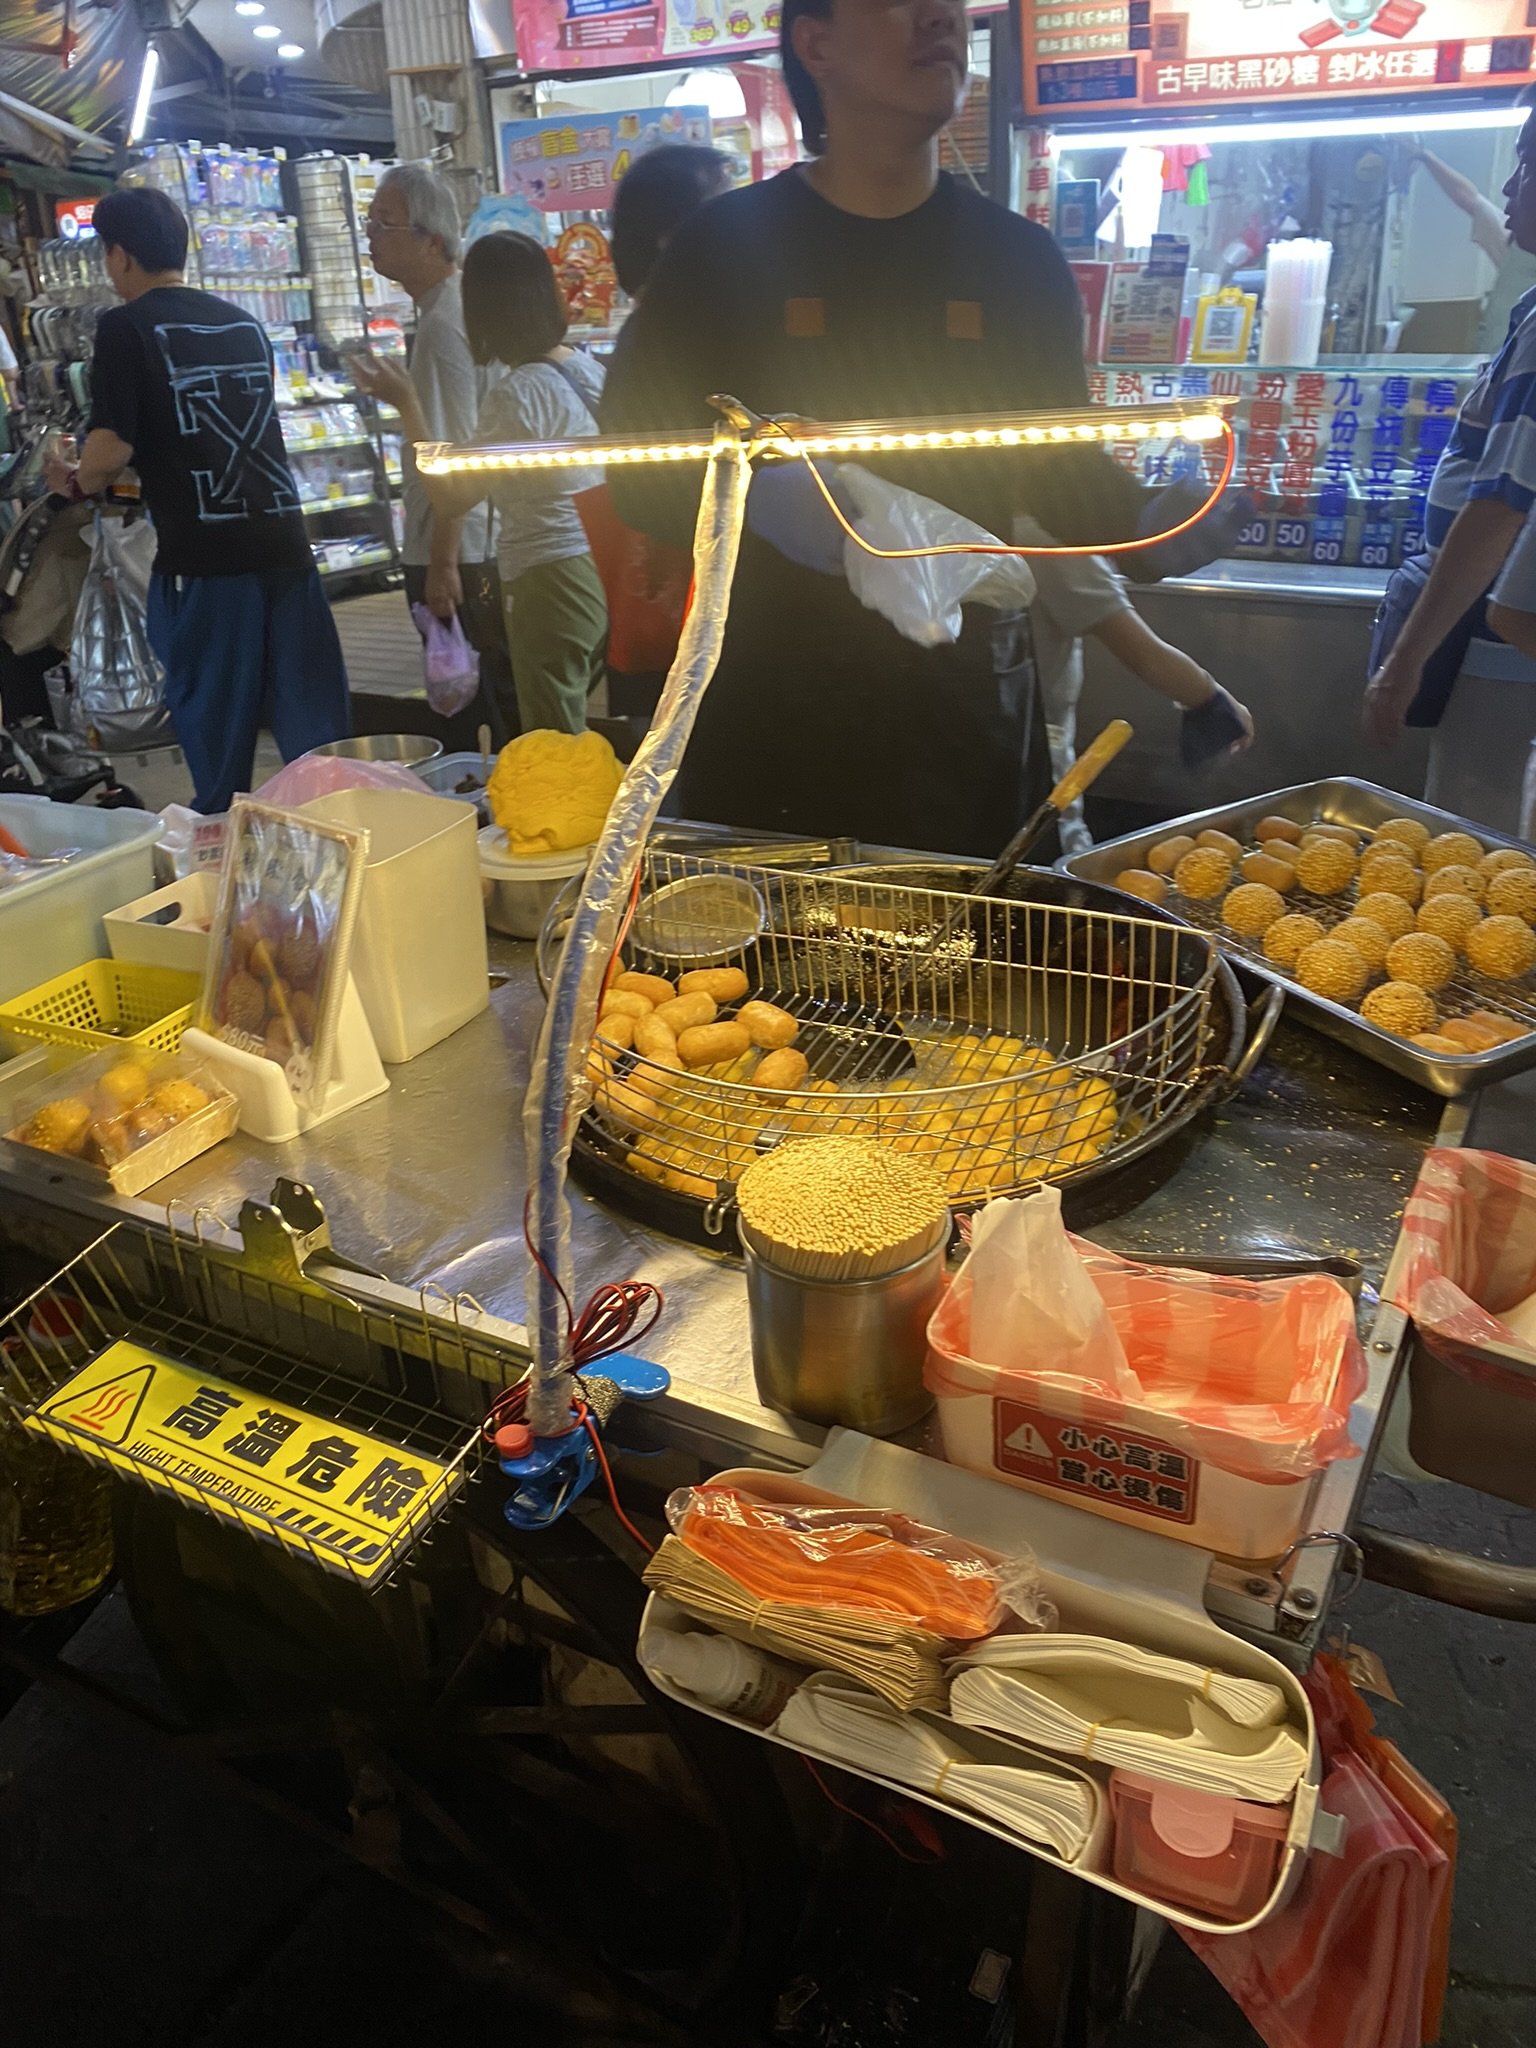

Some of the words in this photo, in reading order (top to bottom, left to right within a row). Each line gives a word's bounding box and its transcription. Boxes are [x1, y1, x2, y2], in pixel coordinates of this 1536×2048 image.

[1156, 54, 1320, 95] 古早味黑砂糖
[1277, 524, 1306, 545] 50
[1313, 541, 1340, 561] 60
[1361, 545, 1388, 565] 60
[128, 1440, 178, 1471] HIGHT
[176, 1458, 281, 1513] TEMPERATURE
[161, 1385, 428, 1522] 高溫危險
[1059, 1426, 1188, 1481] 小心高溫
[1059, 1457, 1187, 1512] 當心燙傷
